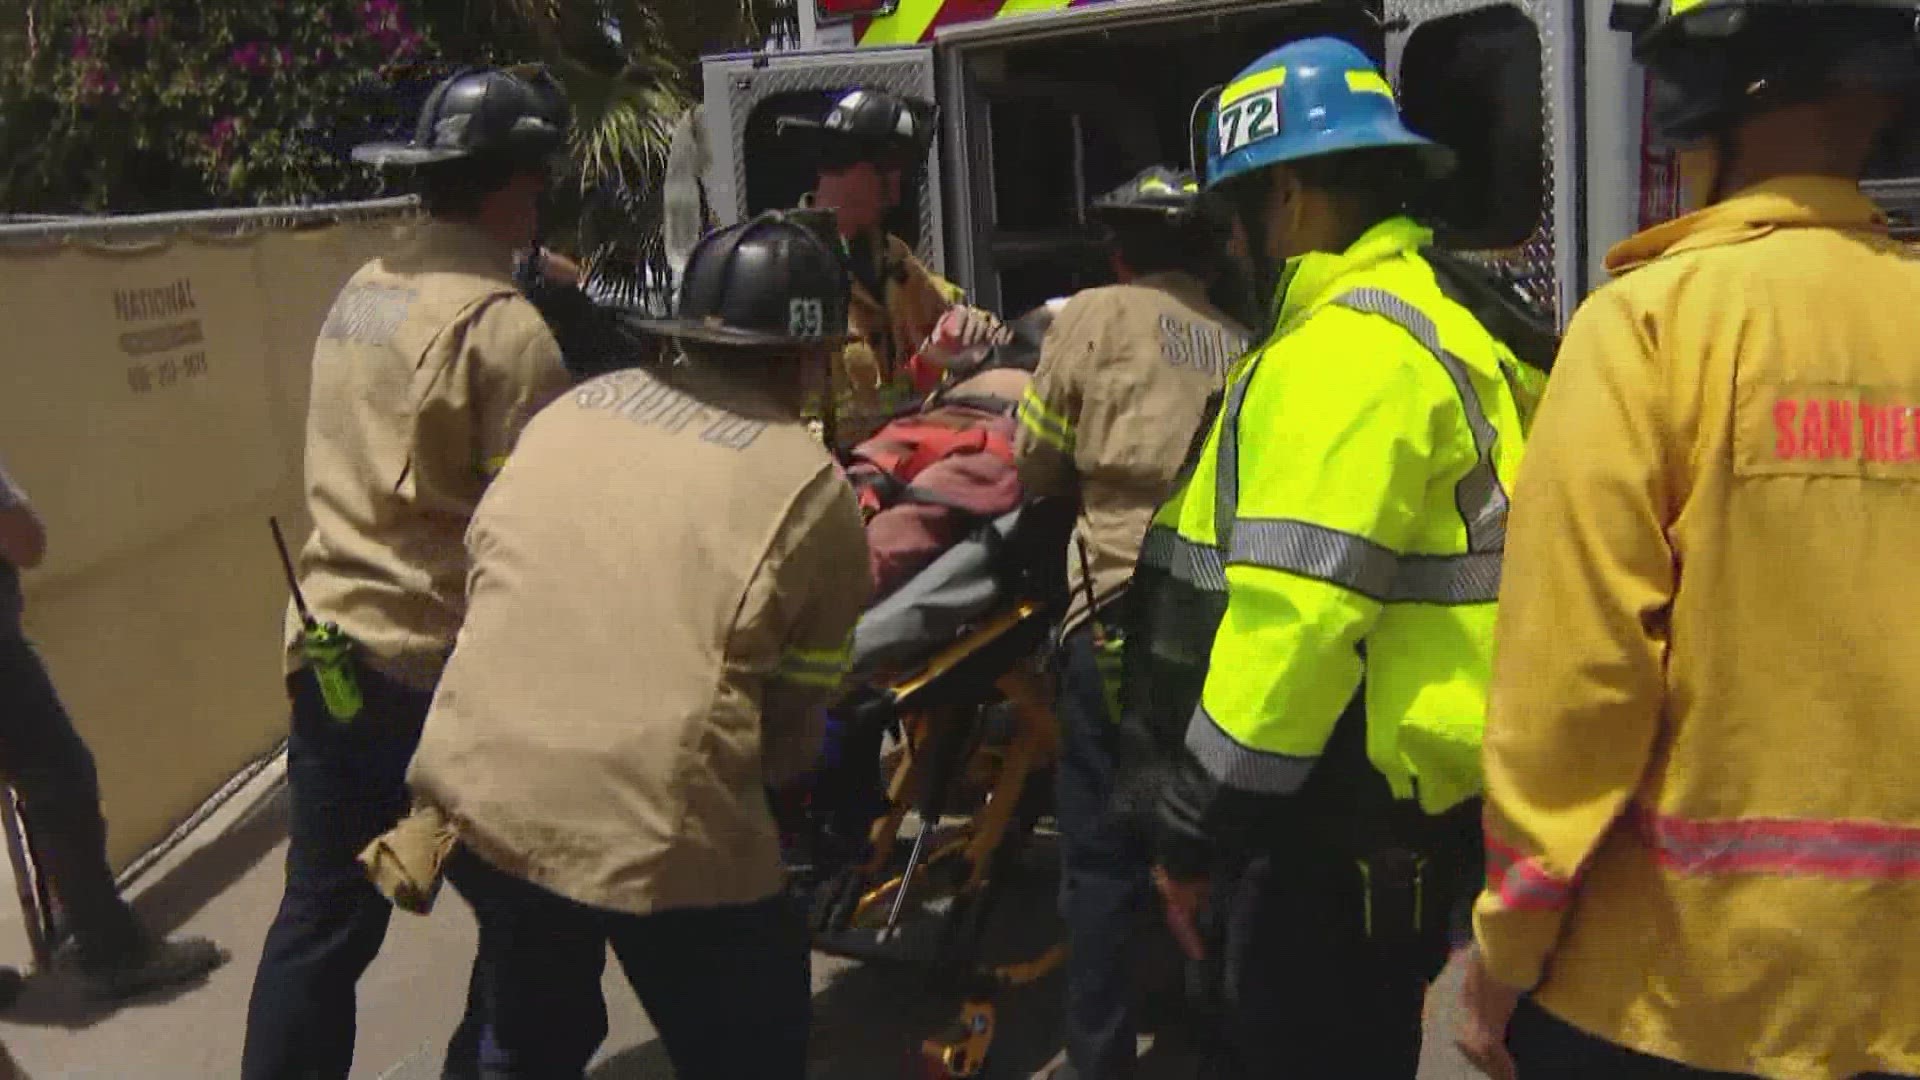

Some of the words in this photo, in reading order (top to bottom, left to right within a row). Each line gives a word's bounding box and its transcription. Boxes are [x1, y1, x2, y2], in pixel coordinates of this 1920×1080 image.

[1222, 97, 1274, 151] 72
[112, 278, 196, 321] NATIONAL
[1772, 398, 1853, 461] SAN
[1857, 399, 1920, 464] DIE
